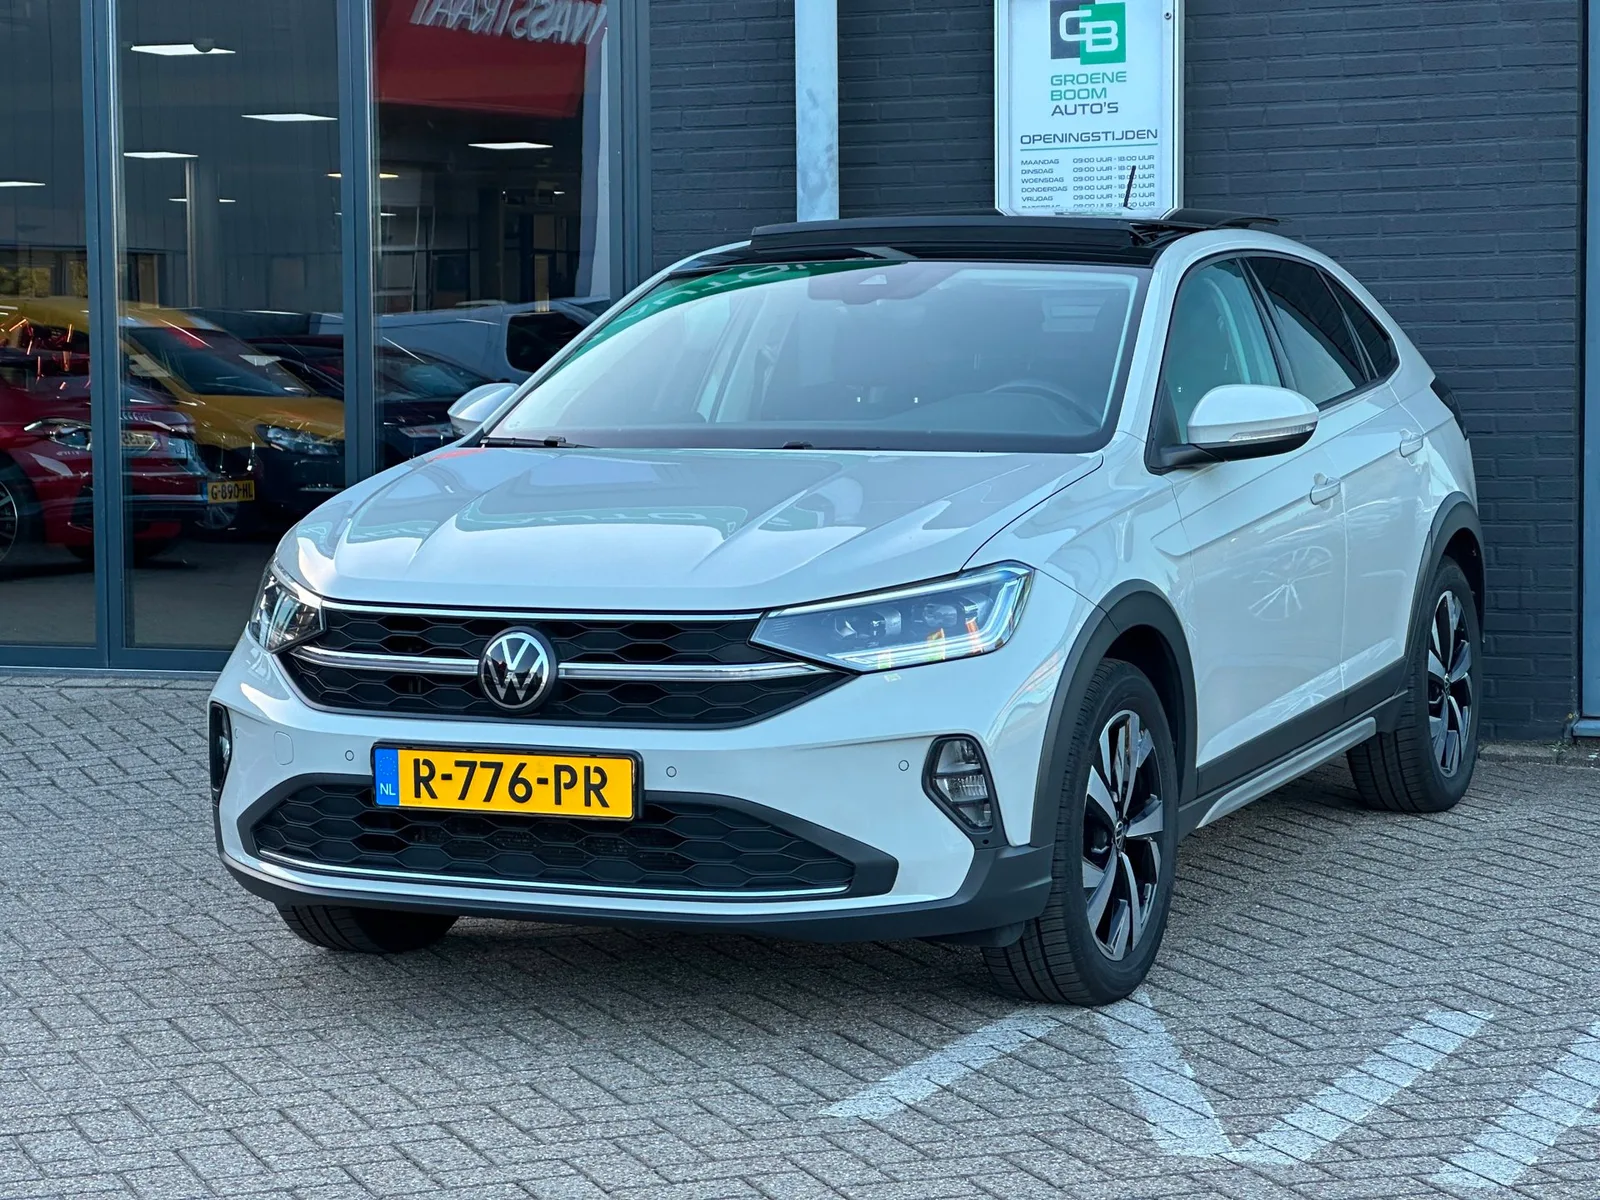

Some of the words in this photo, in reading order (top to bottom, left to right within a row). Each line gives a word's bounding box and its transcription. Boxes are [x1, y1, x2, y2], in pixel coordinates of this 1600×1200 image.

[1050, 70, 1127, 87] GROENE
[1050, 87, 1107, 102] BOOM
[1051, 101, 1119, 117] AUTO'S
[1020, 128, 1158, 145] OPENINGSTIJDEN
[1020, 158, 1060, 166] MAANDAG
[211, 483, 253, 500] G-890-HL
[379, 782, 396, 797] NL
[412, 757, 610, 808] R-776-PR
